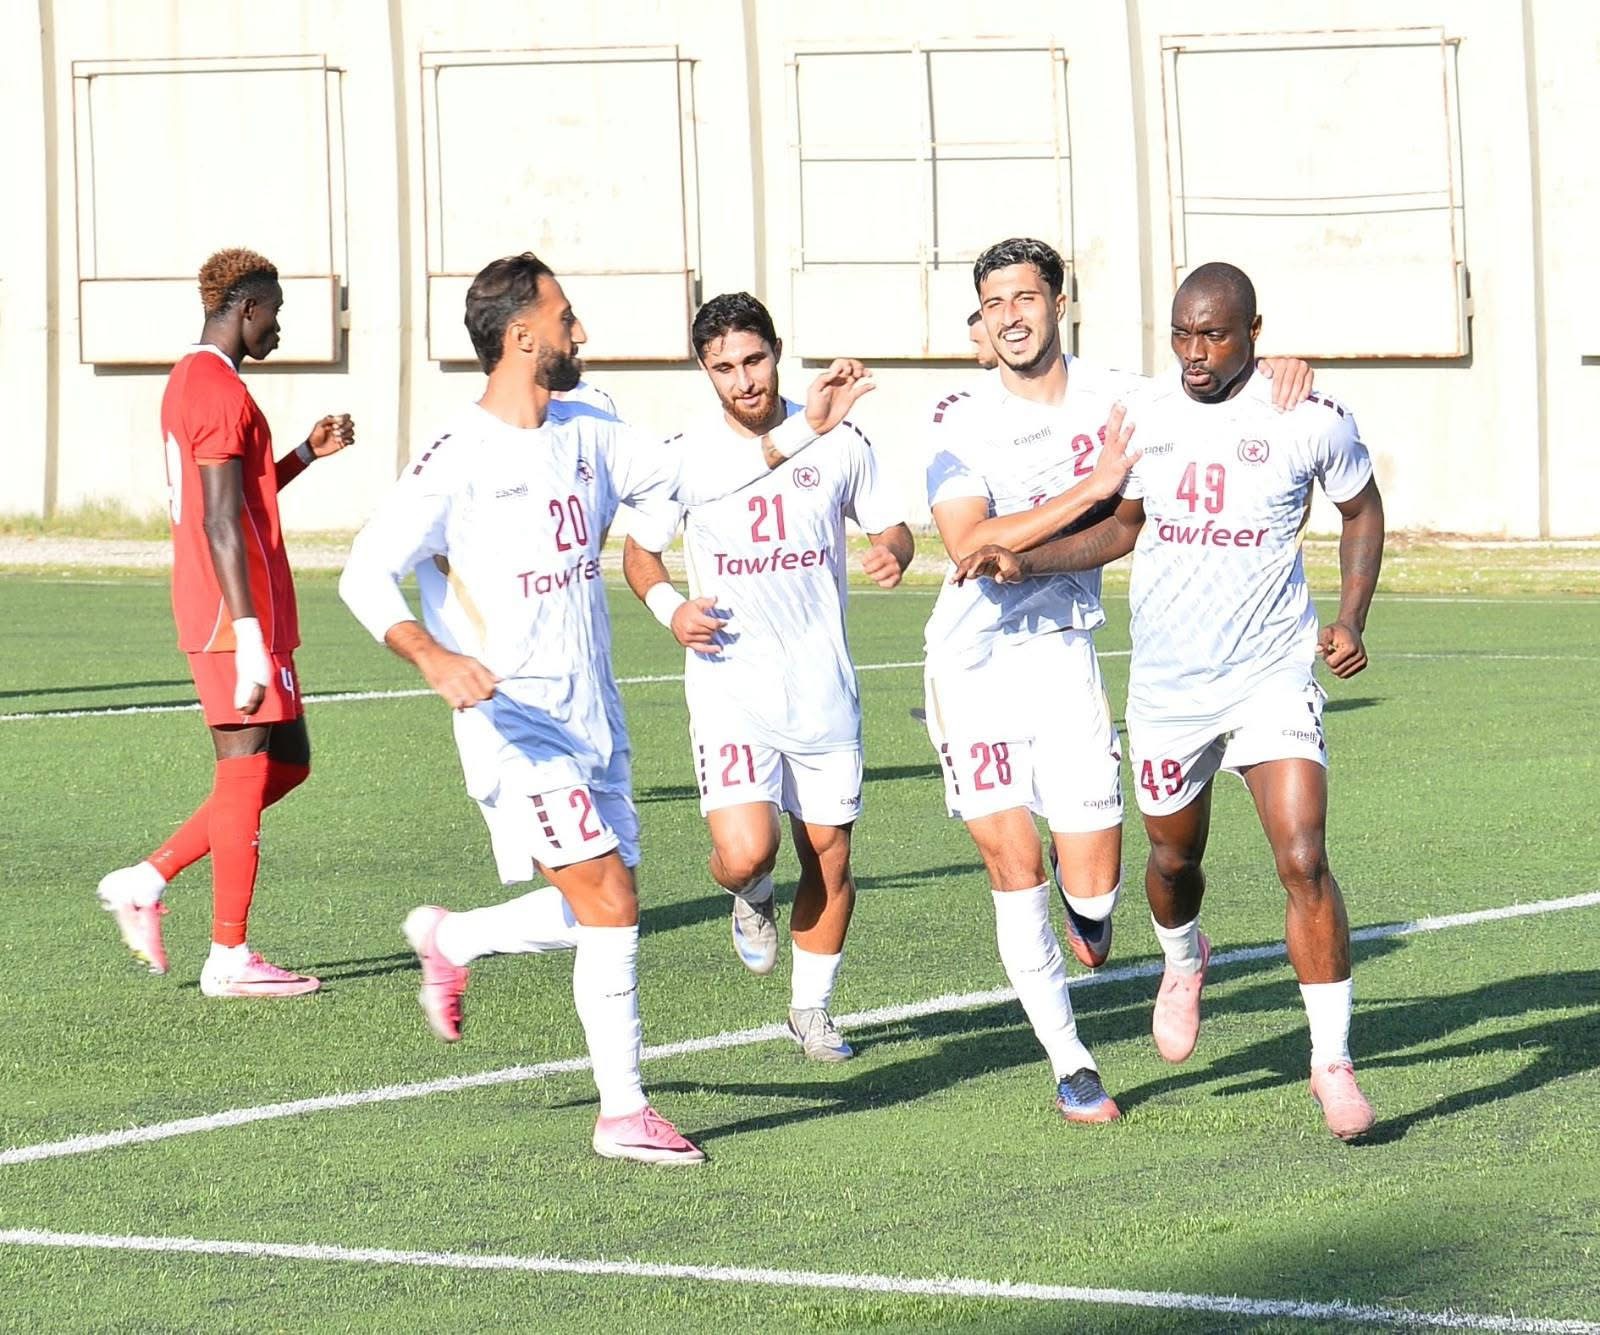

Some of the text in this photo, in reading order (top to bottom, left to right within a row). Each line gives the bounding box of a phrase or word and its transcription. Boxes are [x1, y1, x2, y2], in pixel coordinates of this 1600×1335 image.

[1176, 461, 1226, 514] 49
[549, 495, 588, 552] 20
[748, 494, 786, 543] 21
[1154, 518, 1270, 547] Tawfeer
[719, 743, 756, 787] 21
[970, 742, 1012, 791] 28
[1140, 758, 1184, 801] 49
[569, 788, 601, 842] 2
